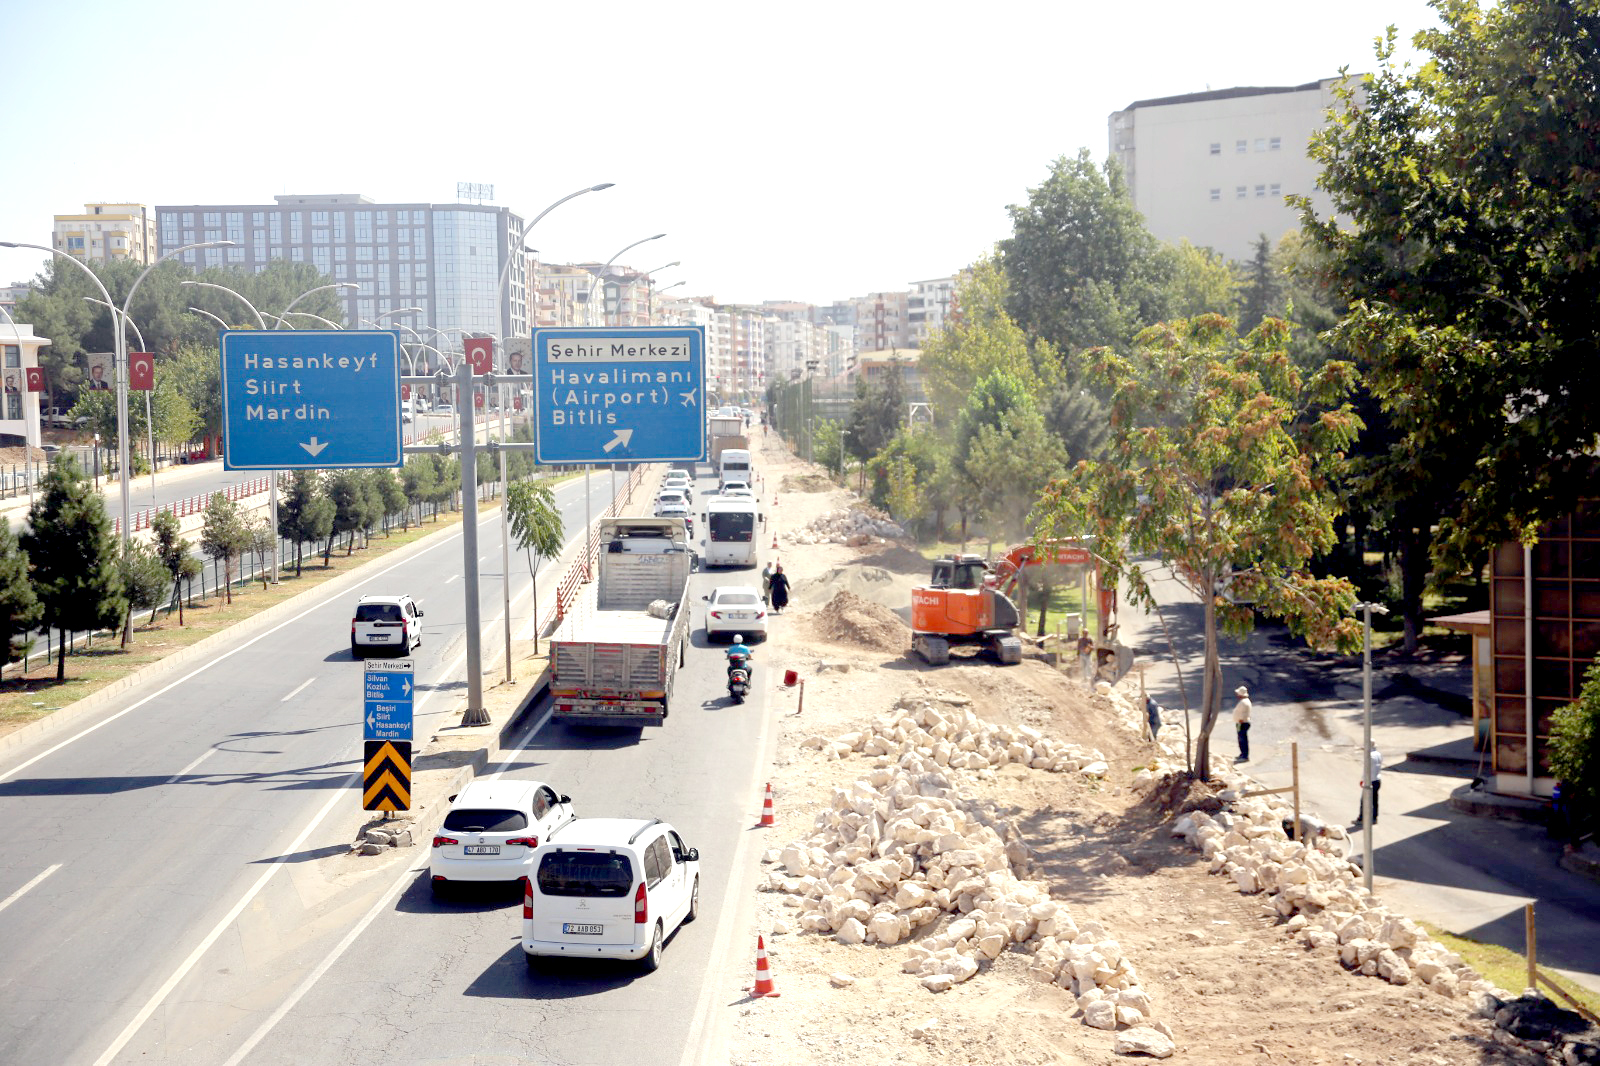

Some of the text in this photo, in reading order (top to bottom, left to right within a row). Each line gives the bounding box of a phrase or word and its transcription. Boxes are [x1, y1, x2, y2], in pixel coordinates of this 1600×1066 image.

[551, 343, 688, 360] Şehir Merkezi
[244, 352, 378, 372] Hasankeyf
[551, 368, 691, 385] Havalimanı
[245, 378, 301, 395] Siirt
[552, 386, 669, 409] (Airport)
[246, 404, 331, 421] Mardin
[552, 409, 617, 425] Bitlis
[383, 662, 404, 670] Merkezi
[376, 705, 396, 713] Beşiri
[376, 722, 411, 731] Hasankeyf
